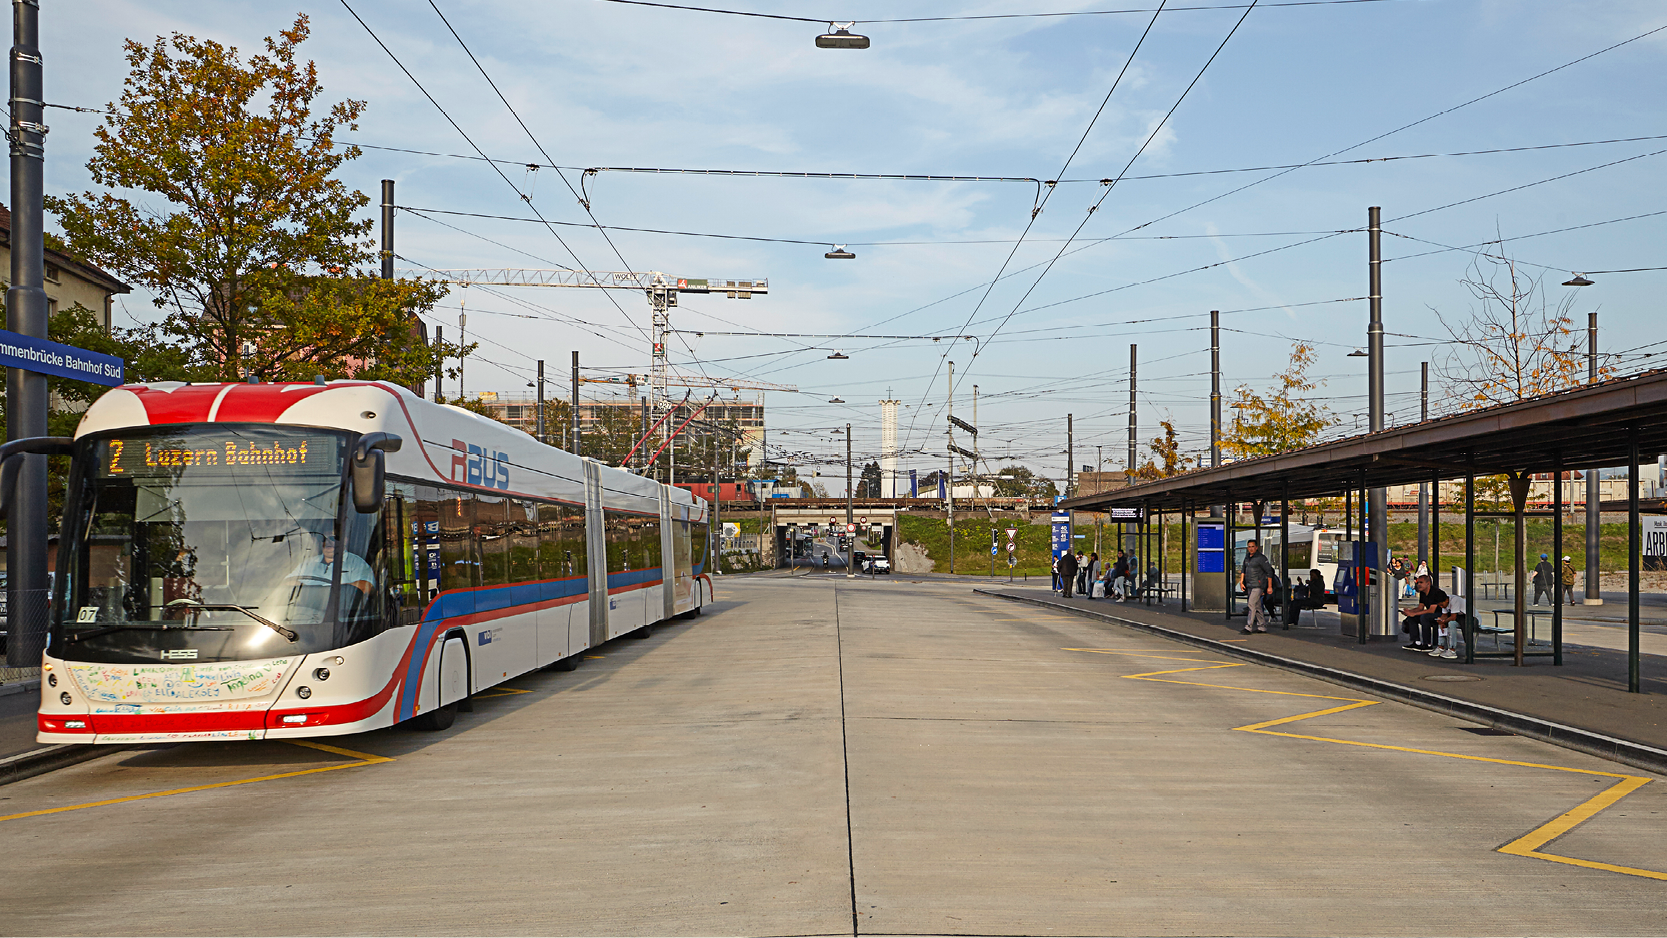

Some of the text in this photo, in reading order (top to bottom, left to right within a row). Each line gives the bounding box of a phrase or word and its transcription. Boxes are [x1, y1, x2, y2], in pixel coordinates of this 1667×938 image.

[65, 355, 103, 375] Bahnhof
[104, 364, 121, 378] Süd
[109, 439, 307, 473] 2 Luzern Bahnhof
[451, 438, 509, 490] RBUS
[1646, 531, 1667, 557] ARB
[80, 609, 96, 621] 07
[161, 649, 198, 660] HESS
